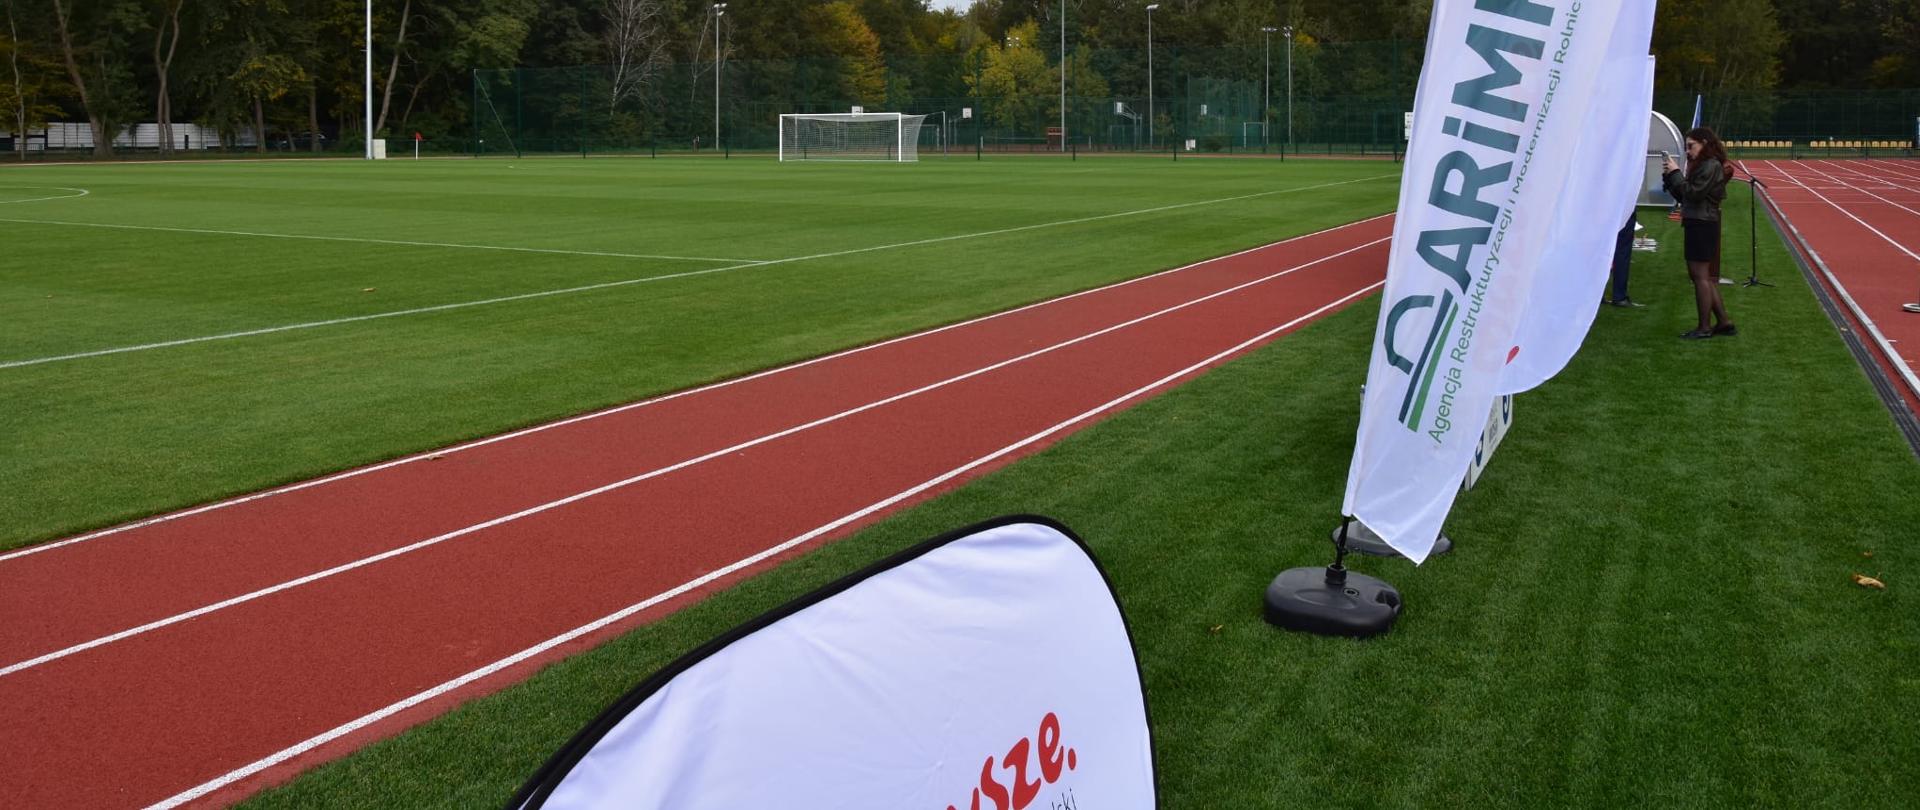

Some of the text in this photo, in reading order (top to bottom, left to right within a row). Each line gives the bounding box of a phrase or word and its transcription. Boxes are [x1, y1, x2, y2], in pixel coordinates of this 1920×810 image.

[1427, 366, 1463, 444] Agencja
[1456, 207, 1514, 364] Restrukturyzacji
[1512, 68, 1562, 195] Modernizacji
